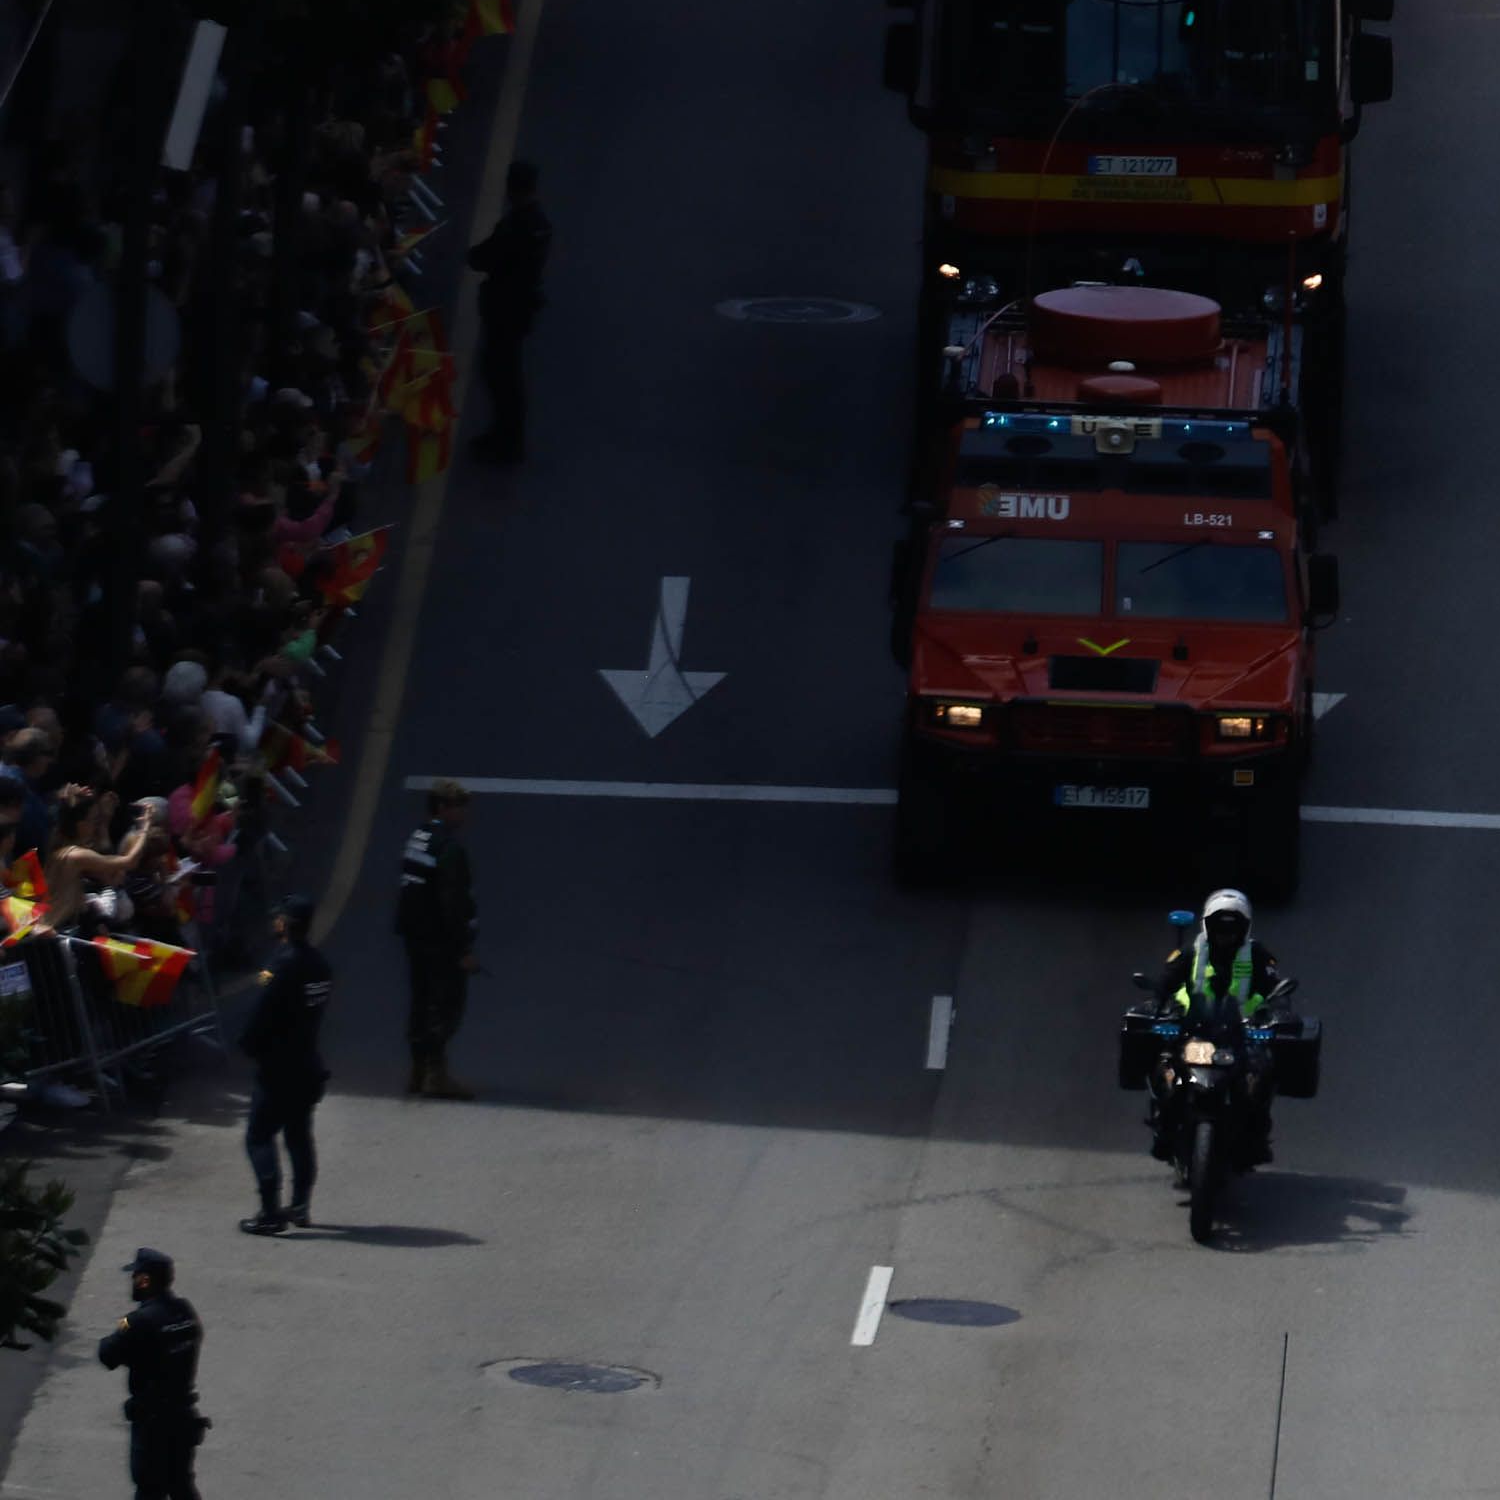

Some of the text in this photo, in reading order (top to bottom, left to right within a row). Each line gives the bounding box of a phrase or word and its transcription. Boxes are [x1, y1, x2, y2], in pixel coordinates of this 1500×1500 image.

[1096, 158, 1173, 173] ET 121277
[1184, 512, 1232, 526] LB-521
